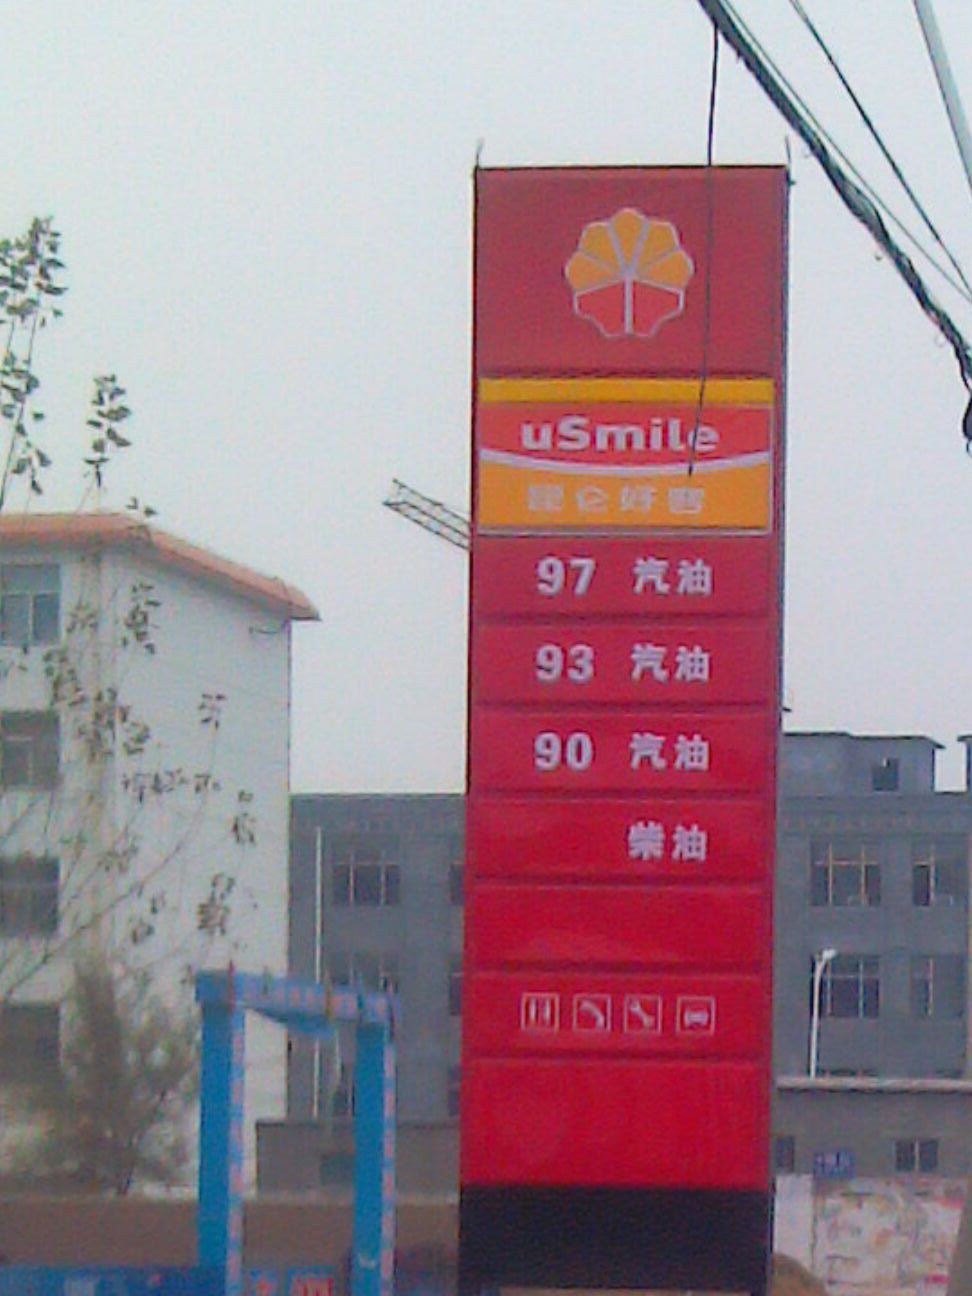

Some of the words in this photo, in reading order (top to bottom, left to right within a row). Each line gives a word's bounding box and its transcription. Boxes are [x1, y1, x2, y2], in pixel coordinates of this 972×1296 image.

[521, 414, 719, 451] uSmile
[535, 556, 597, 596] 97
[633, 556, 713, 596] 汽油
[534, 644, 595, 682] 93
[630, 644, 711, 682] 汽油
[534, 732, 594, 771] 90
[629, 732, 710, 771] 汽油
[627, 820, 707, 861] 柴油
